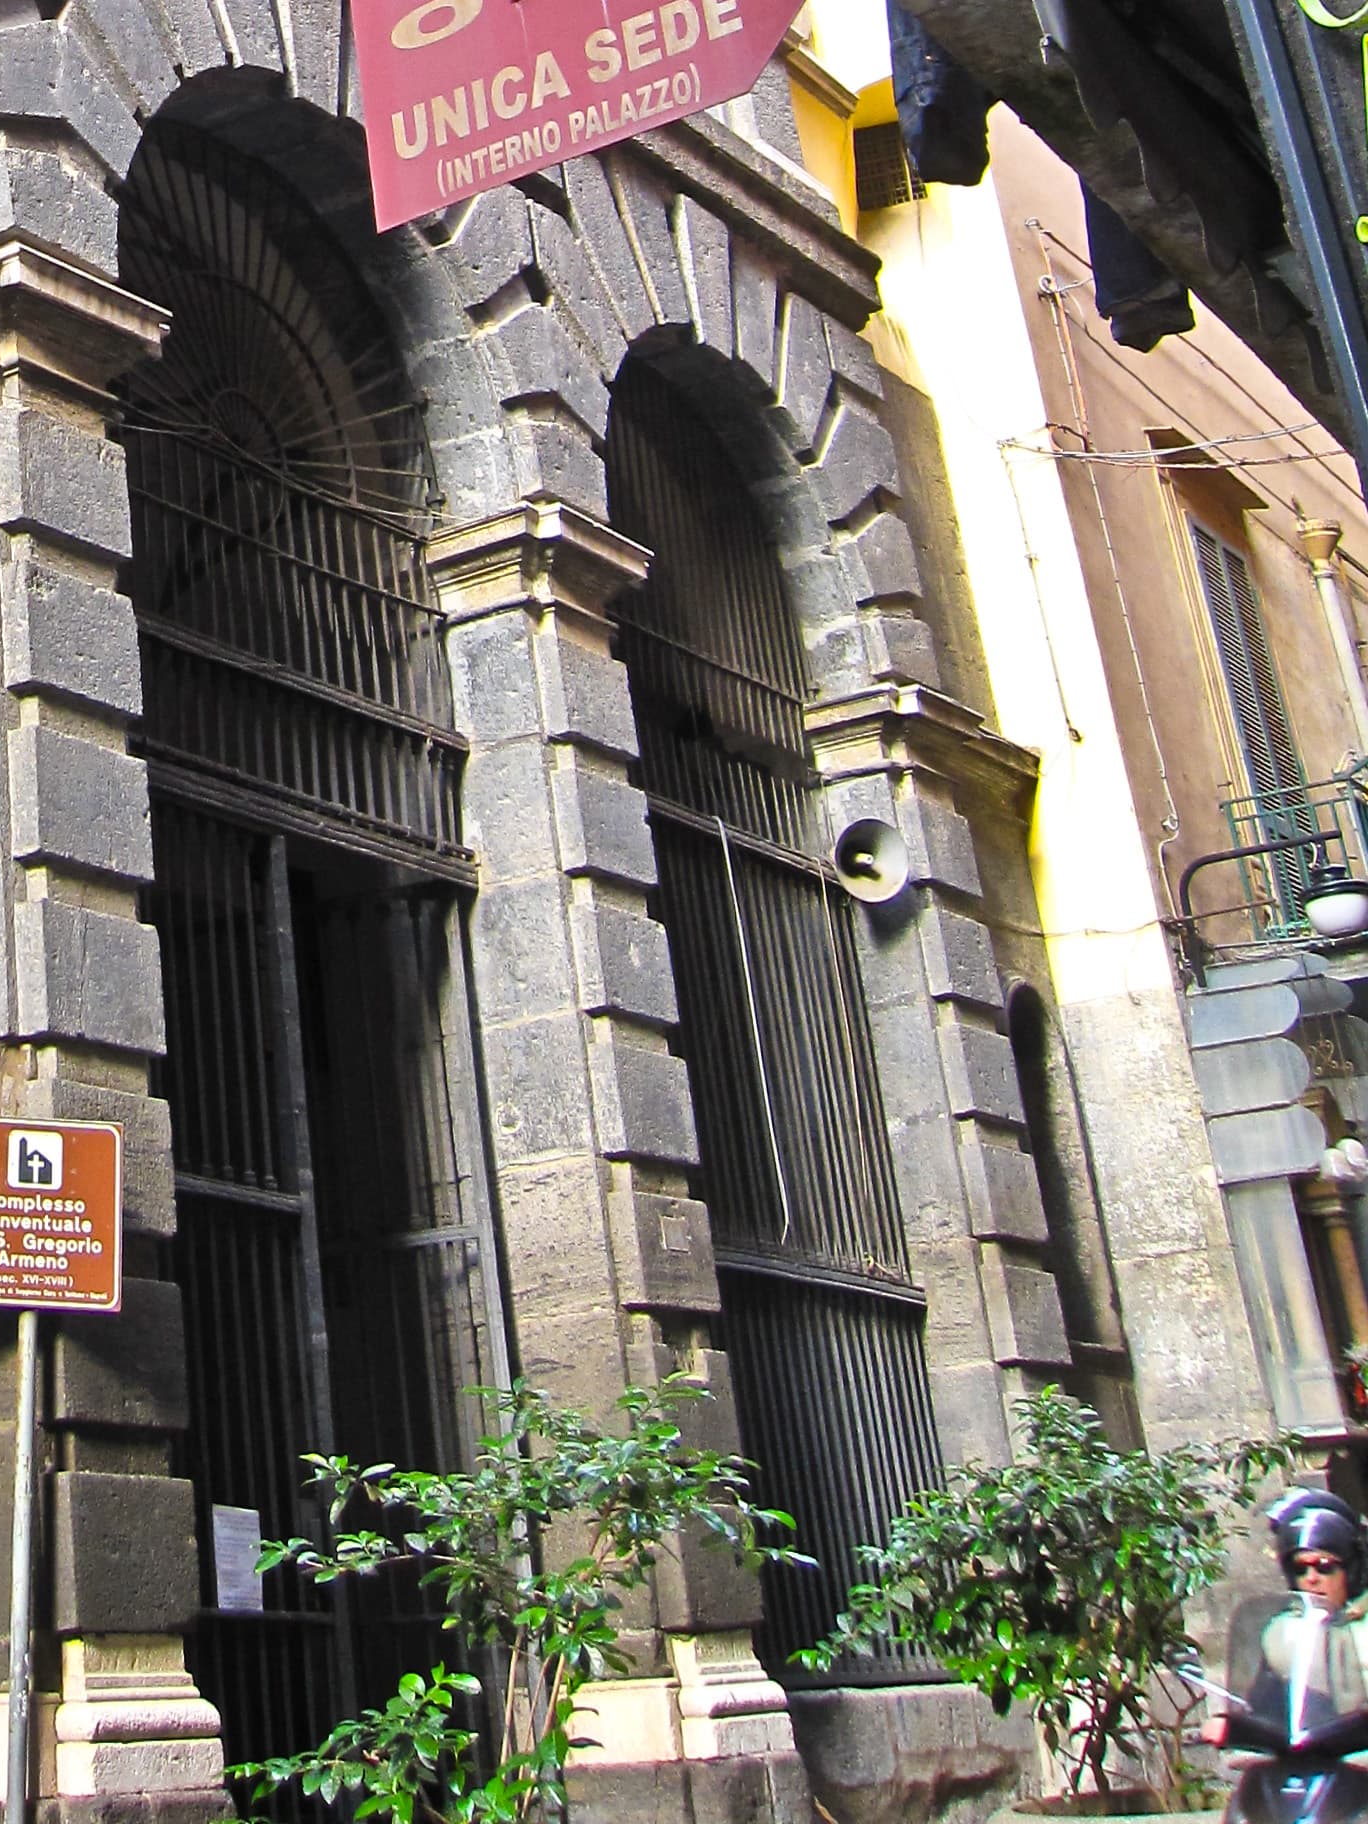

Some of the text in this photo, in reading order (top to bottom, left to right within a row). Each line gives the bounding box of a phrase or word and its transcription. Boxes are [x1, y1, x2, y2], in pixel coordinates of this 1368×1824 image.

[391, 50, 570, 160] UNICA
[435, 63, 702, 199] (INTERNO PALAZZO)
[22, 1233, 103, 1255] Gregorio
